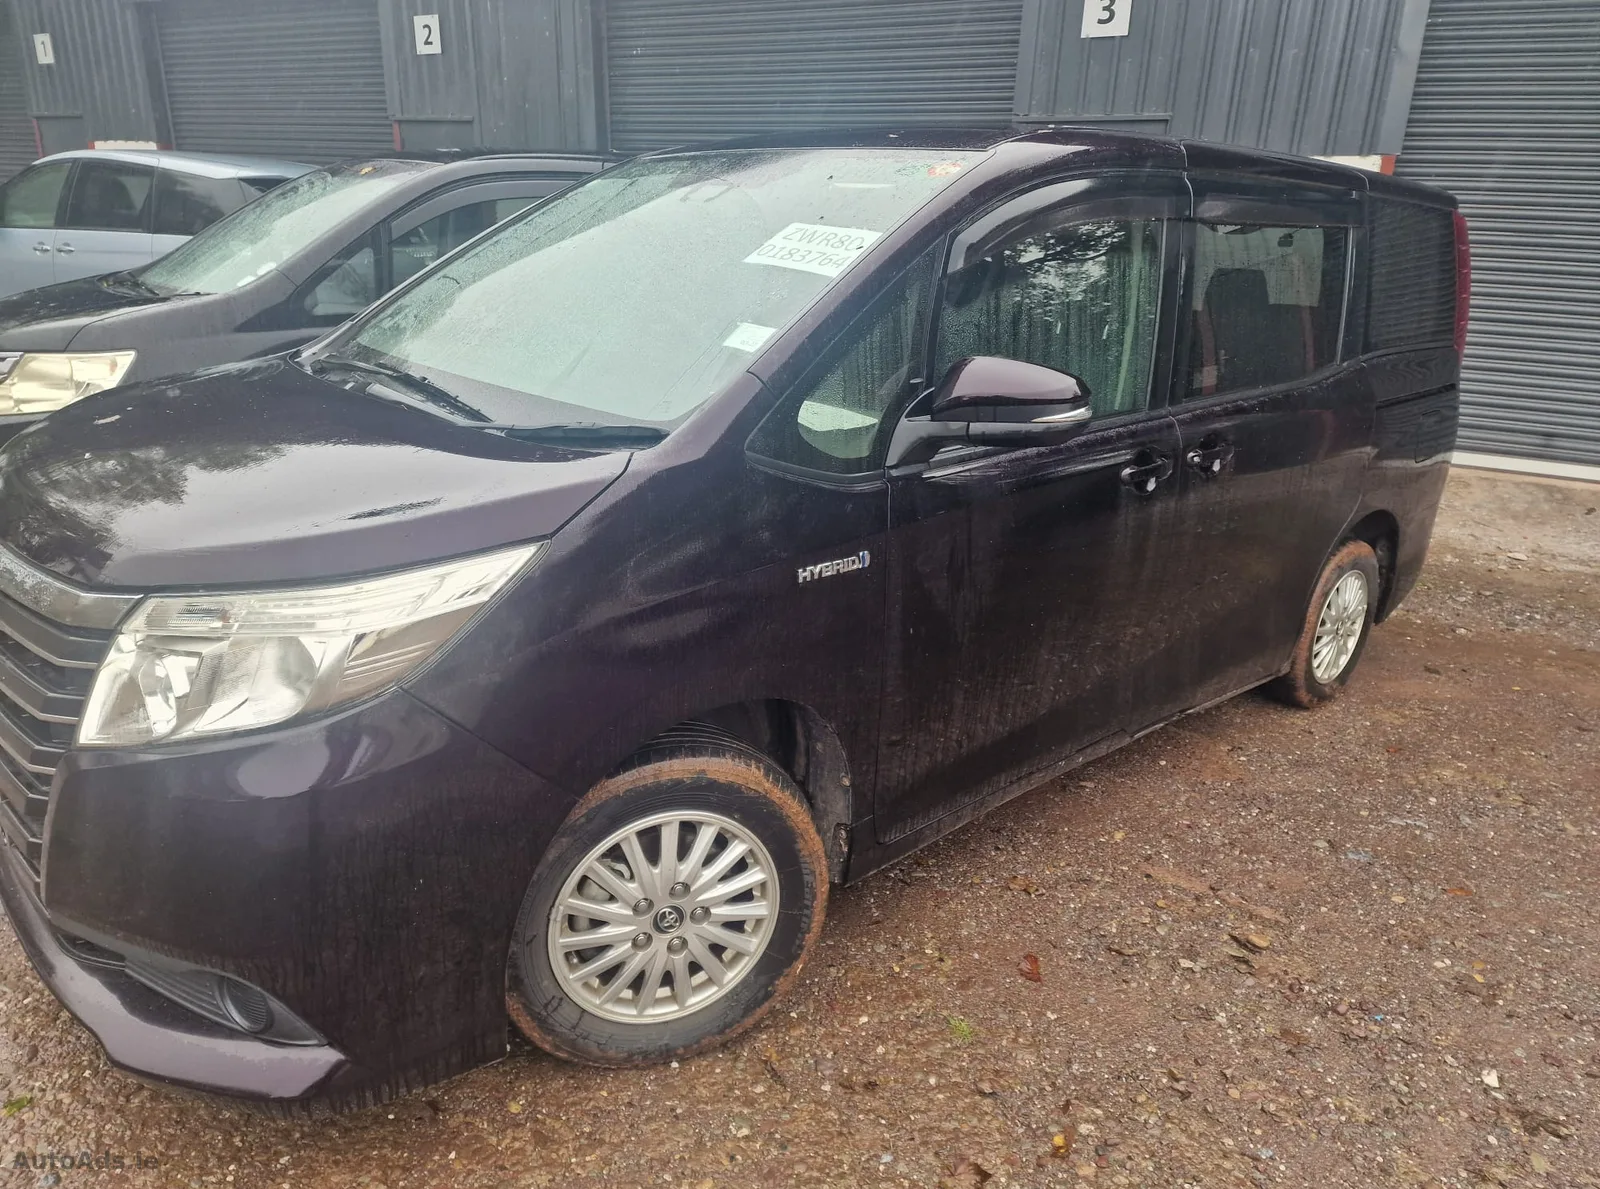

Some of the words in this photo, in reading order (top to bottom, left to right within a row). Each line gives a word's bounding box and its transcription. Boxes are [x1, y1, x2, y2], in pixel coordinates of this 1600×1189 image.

[1097, 0, 1116, 25] 3
[422, 24, 433, 45] 2
[40, 40, 47, 57] 1
[782, 228, 865, 251] ZWR80
[757, 244, 851, 269] 0183764
[797, 556, 861, 584] HYBRID
